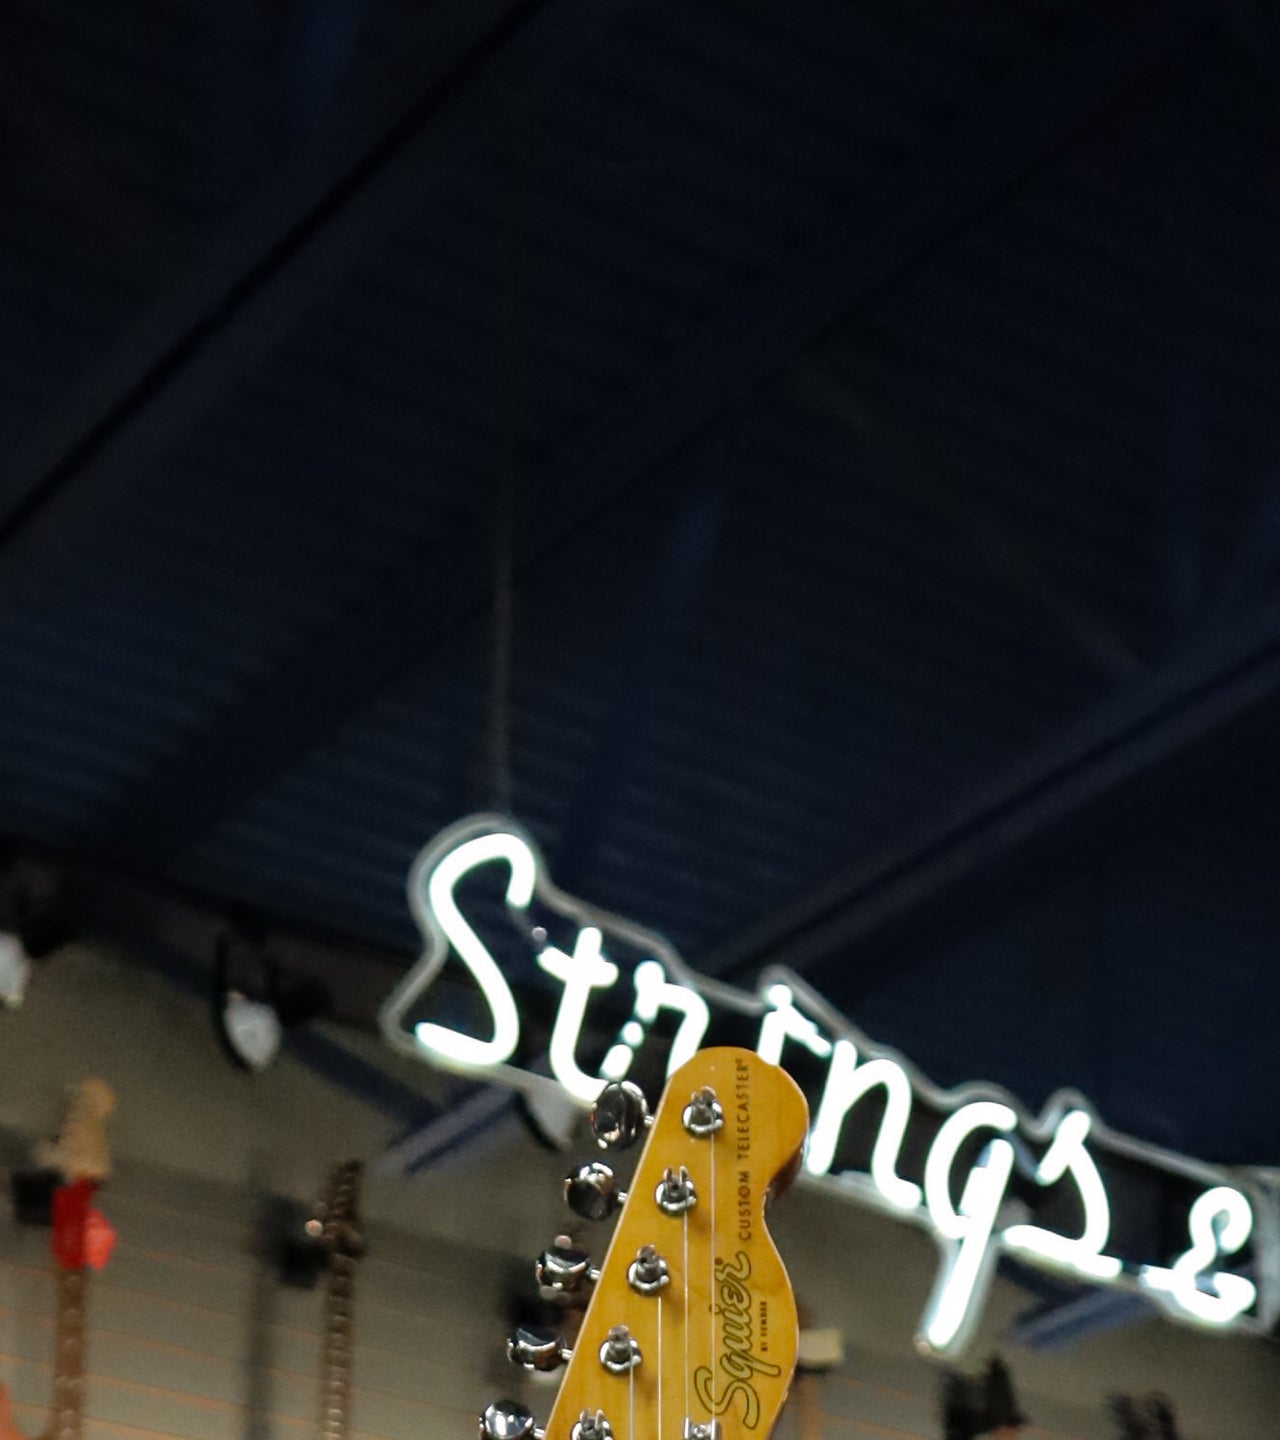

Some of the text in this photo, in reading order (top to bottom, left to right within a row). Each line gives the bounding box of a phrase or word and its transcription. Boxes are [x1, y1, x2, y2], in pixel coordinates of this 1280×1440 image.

[738, 1170, 752, 1242] CUSTOM
[1144, 1187, 1255, 1322] &
[694, 1250, 783, 1430] Squier
